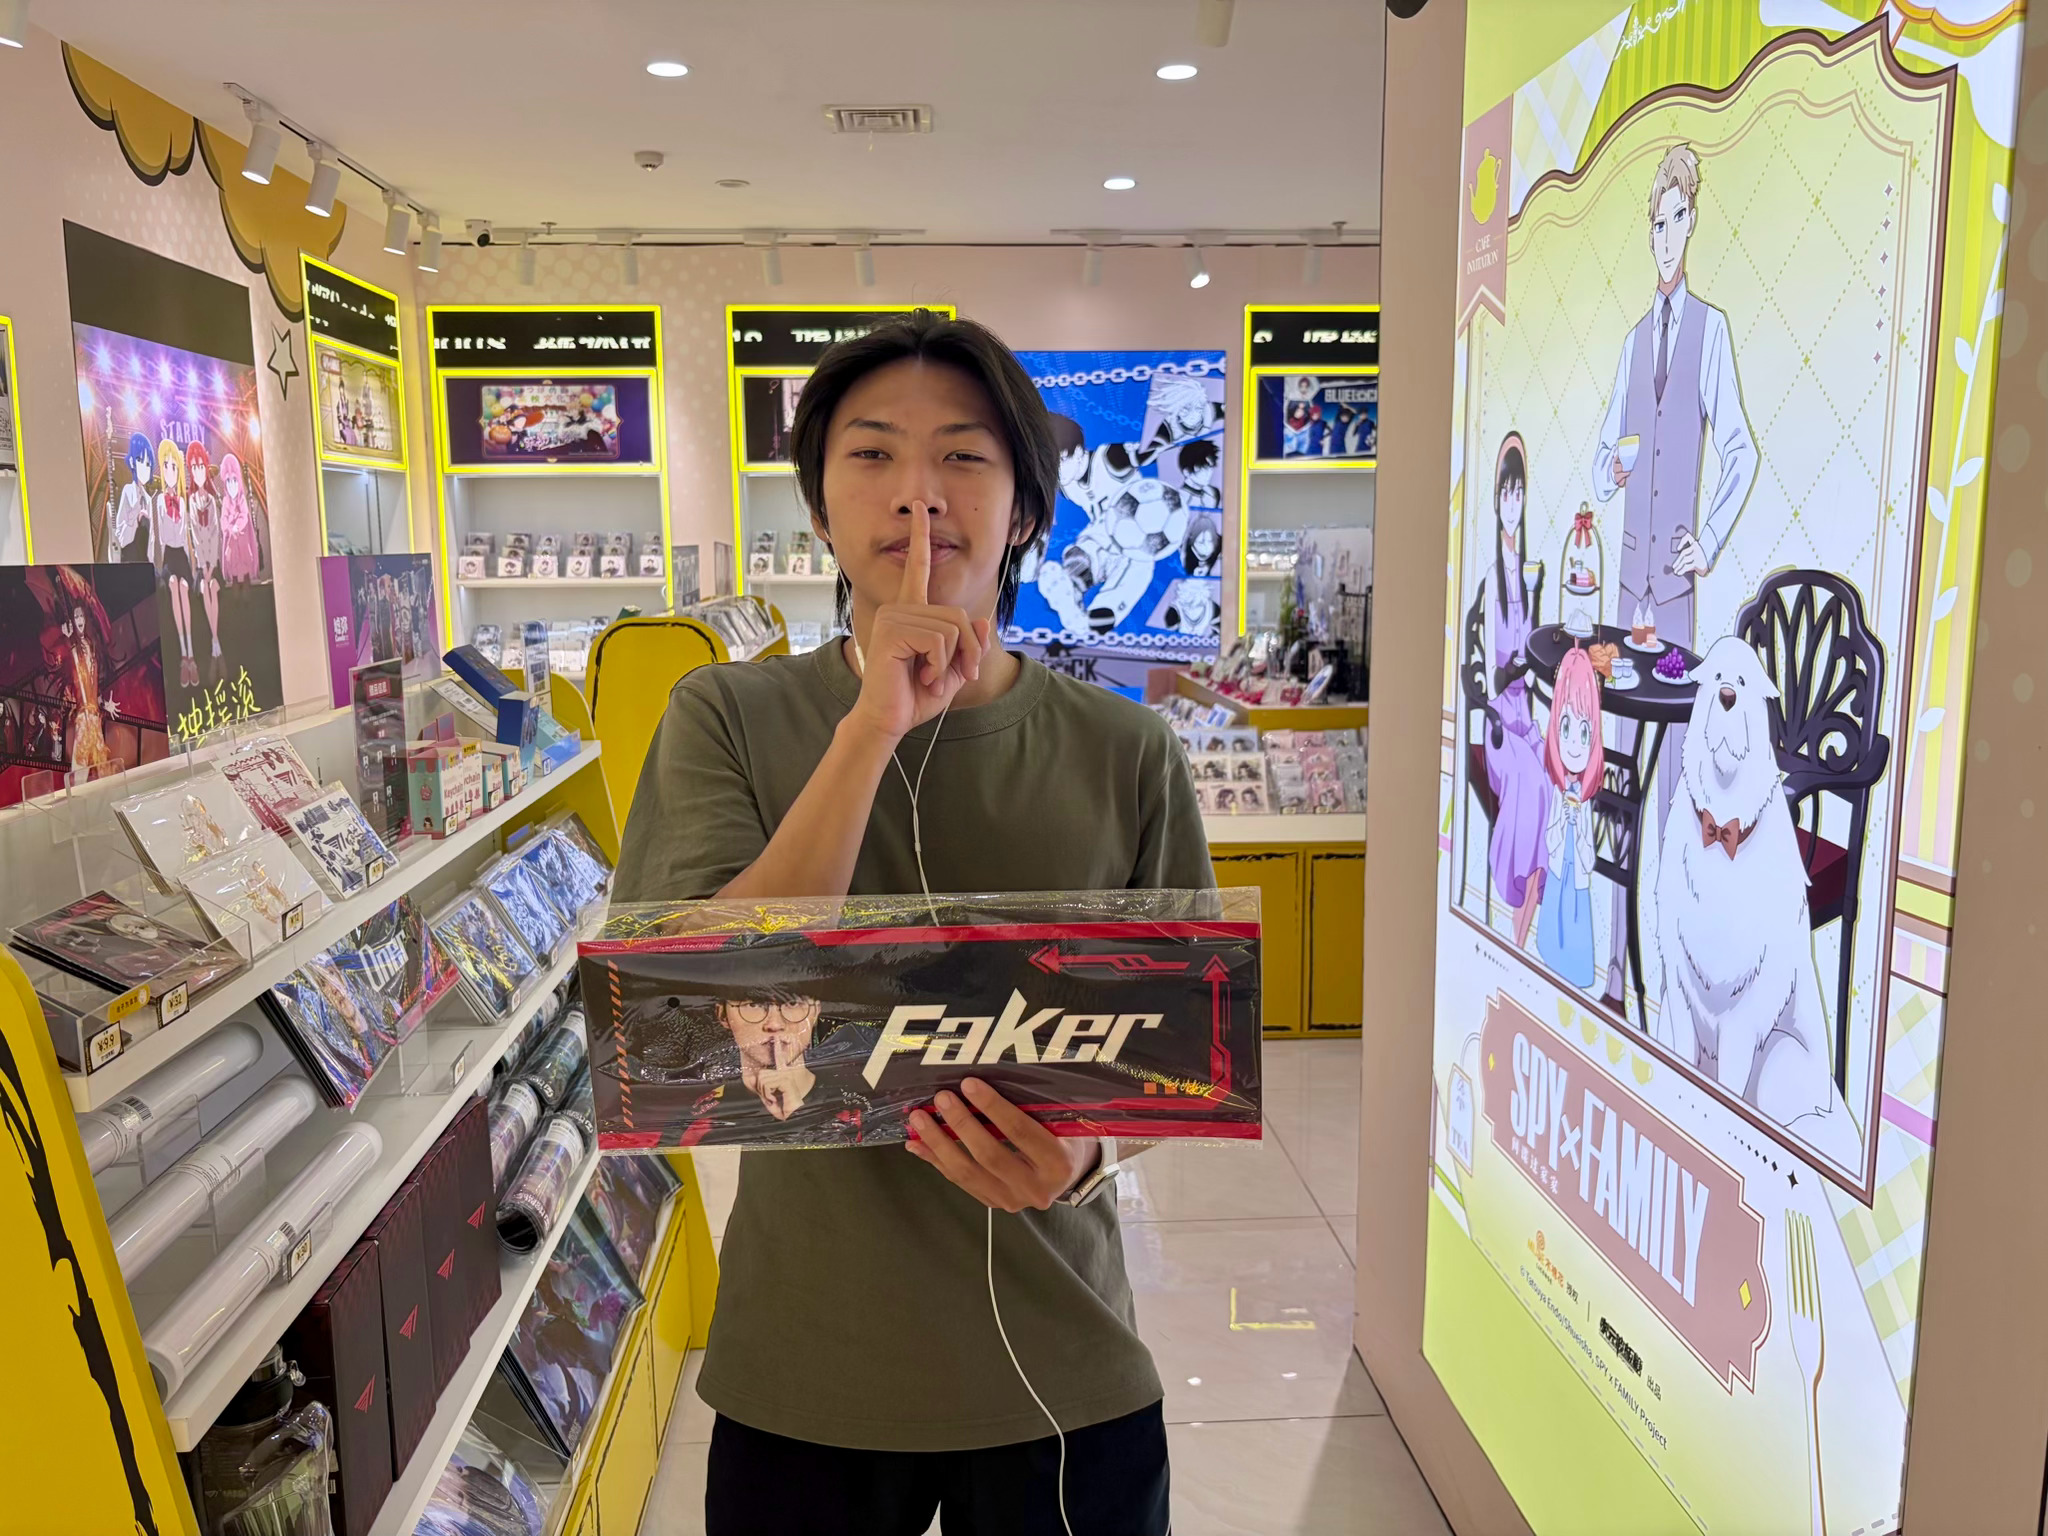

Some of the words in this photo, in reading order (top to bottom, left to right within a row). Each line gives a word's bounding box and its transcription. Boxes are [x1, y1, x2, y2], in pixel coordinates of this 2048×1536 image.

[160, 418, 206, 443] STARRY
[444, 783, 464, 799] Keychain
[862, 988, 1164, 1090] Faker
[1595, 1354, 1609, 1378] SPY
[1614, 1377, 1640, 1415] FAMILY
[1640, 1407, 1668, 1450] Project
